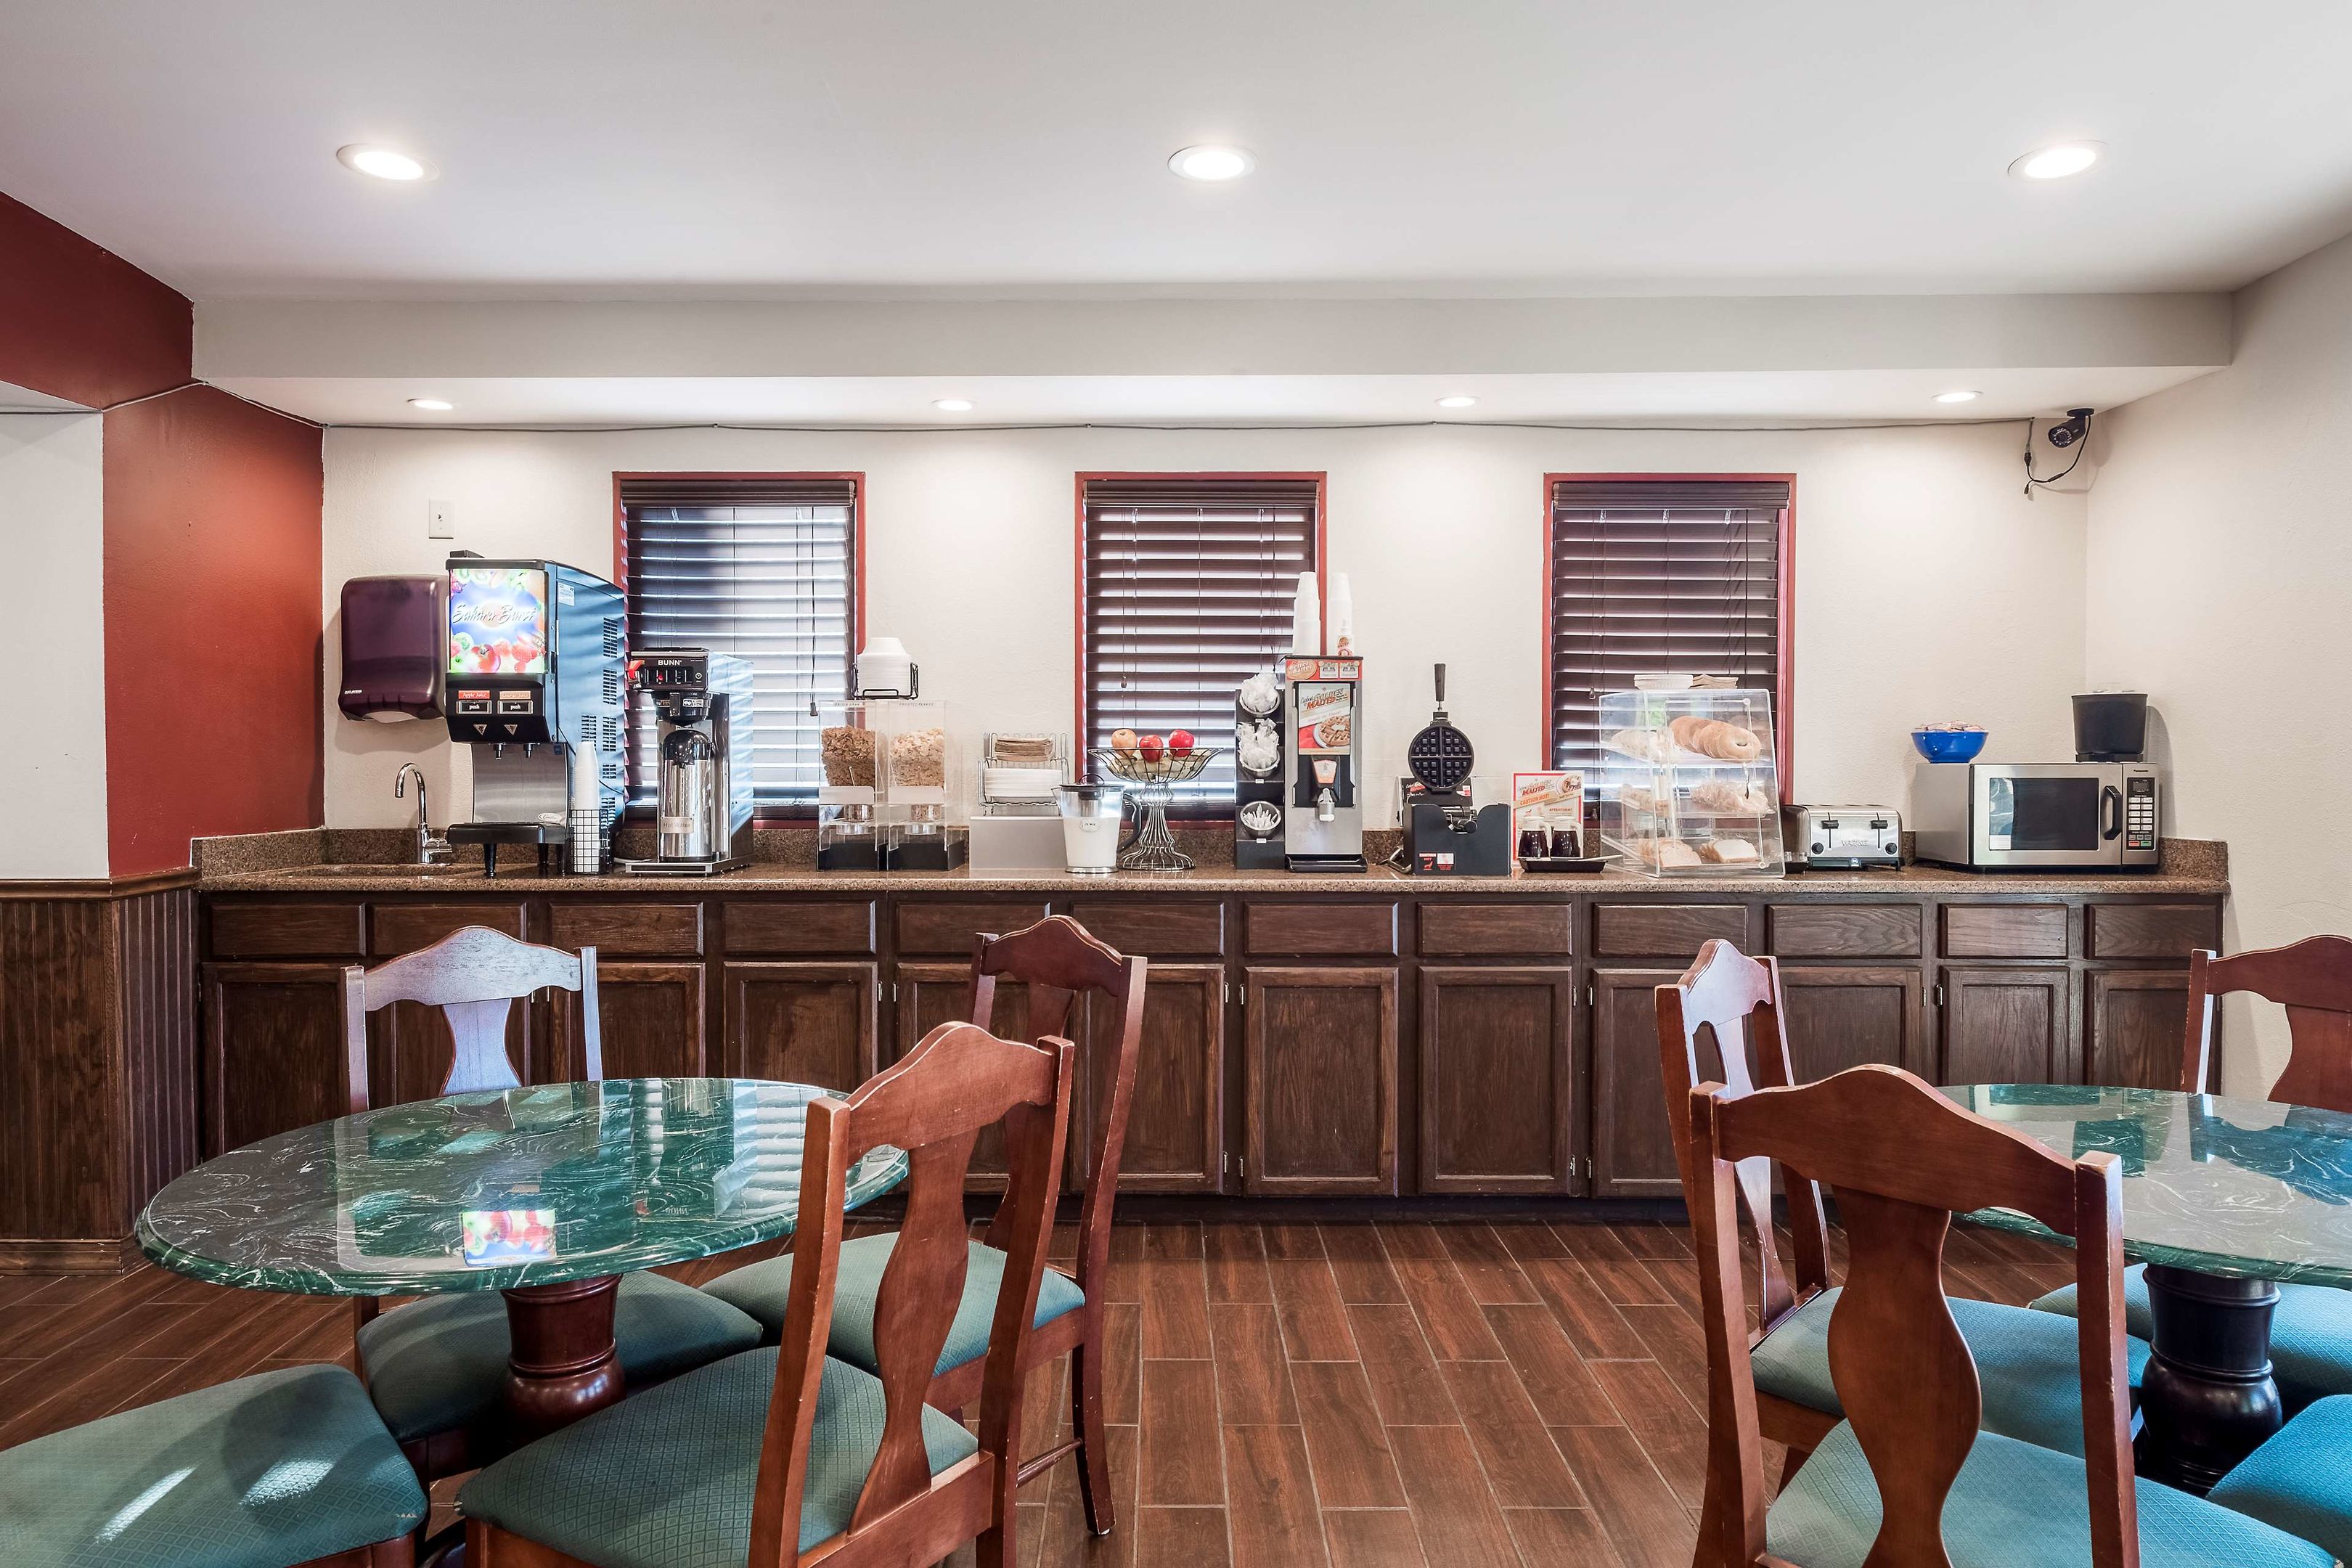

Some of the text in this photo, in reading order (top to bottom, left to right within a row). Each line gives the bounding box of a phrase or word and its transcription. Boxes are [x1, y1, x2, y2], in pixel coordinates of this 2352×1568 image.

[1307, 696, 1336, 709] MALTED
[1522, 785, 1545, 796] MALTED
[1520, 796, 1540, 806] CAUTION
